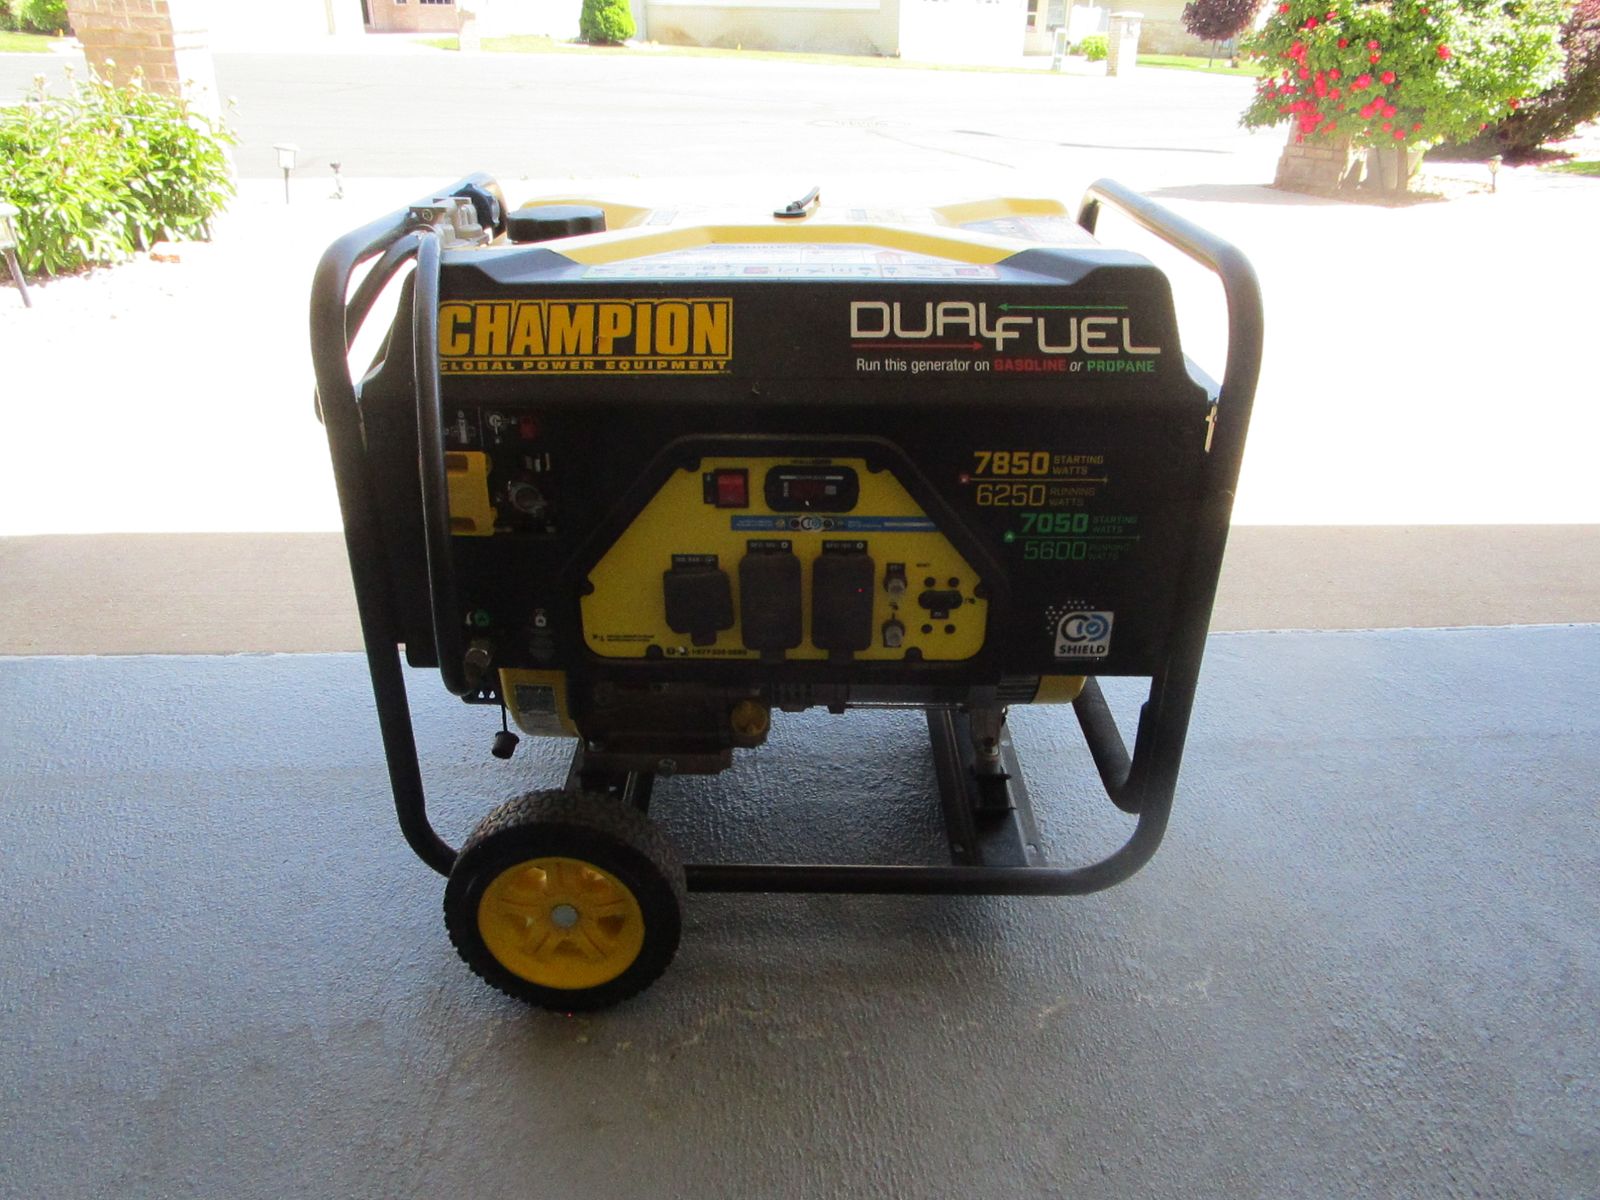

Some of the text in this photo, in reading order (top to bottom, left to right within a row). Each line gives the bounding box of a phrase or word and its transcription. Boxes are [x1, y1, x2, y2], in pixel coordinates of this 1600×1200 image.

[440, 302, 727, 356] CHAMPION
[440, 361, 728, 370] GLOBAL POWER EQUIPMENT
[856, 358, 1155, 374] Run this generator on GASOLINE or PROPANE
[973, 451, 1050, 475] 7850
[1053, 456, 1104, 465] STARTING
[1052, 466, 1088, 475] WATTS
[976, 484, 1046, 506] 6250
[1020, 513, 1089, 533] 7050
[1024, 541, 1088, 560] 5600
[1059, 644, 1106, 655] SHIELD
